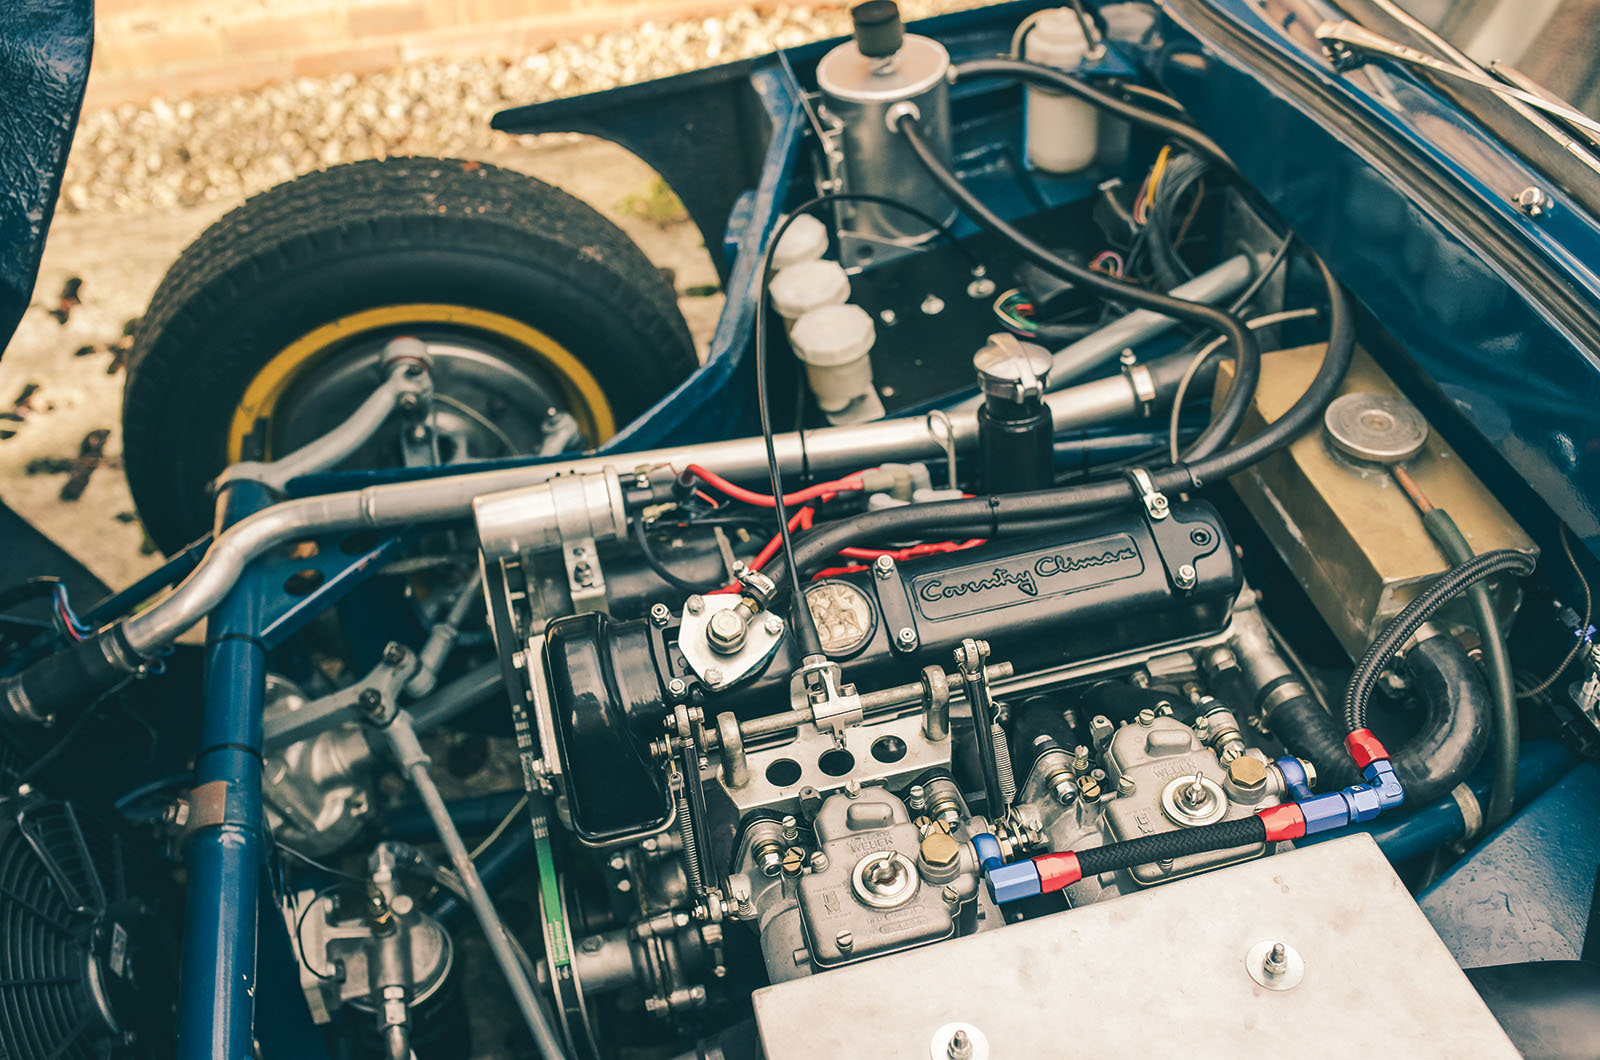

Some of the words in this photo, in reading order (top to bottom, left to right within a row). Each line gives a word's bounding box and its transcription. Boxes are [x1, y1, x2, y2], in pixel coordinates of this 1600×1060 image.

[920, 568, 1038, 602] Coventry
[1034, 547, 1137, 577] Climax
[849, 837, 894, 853] WEBER
